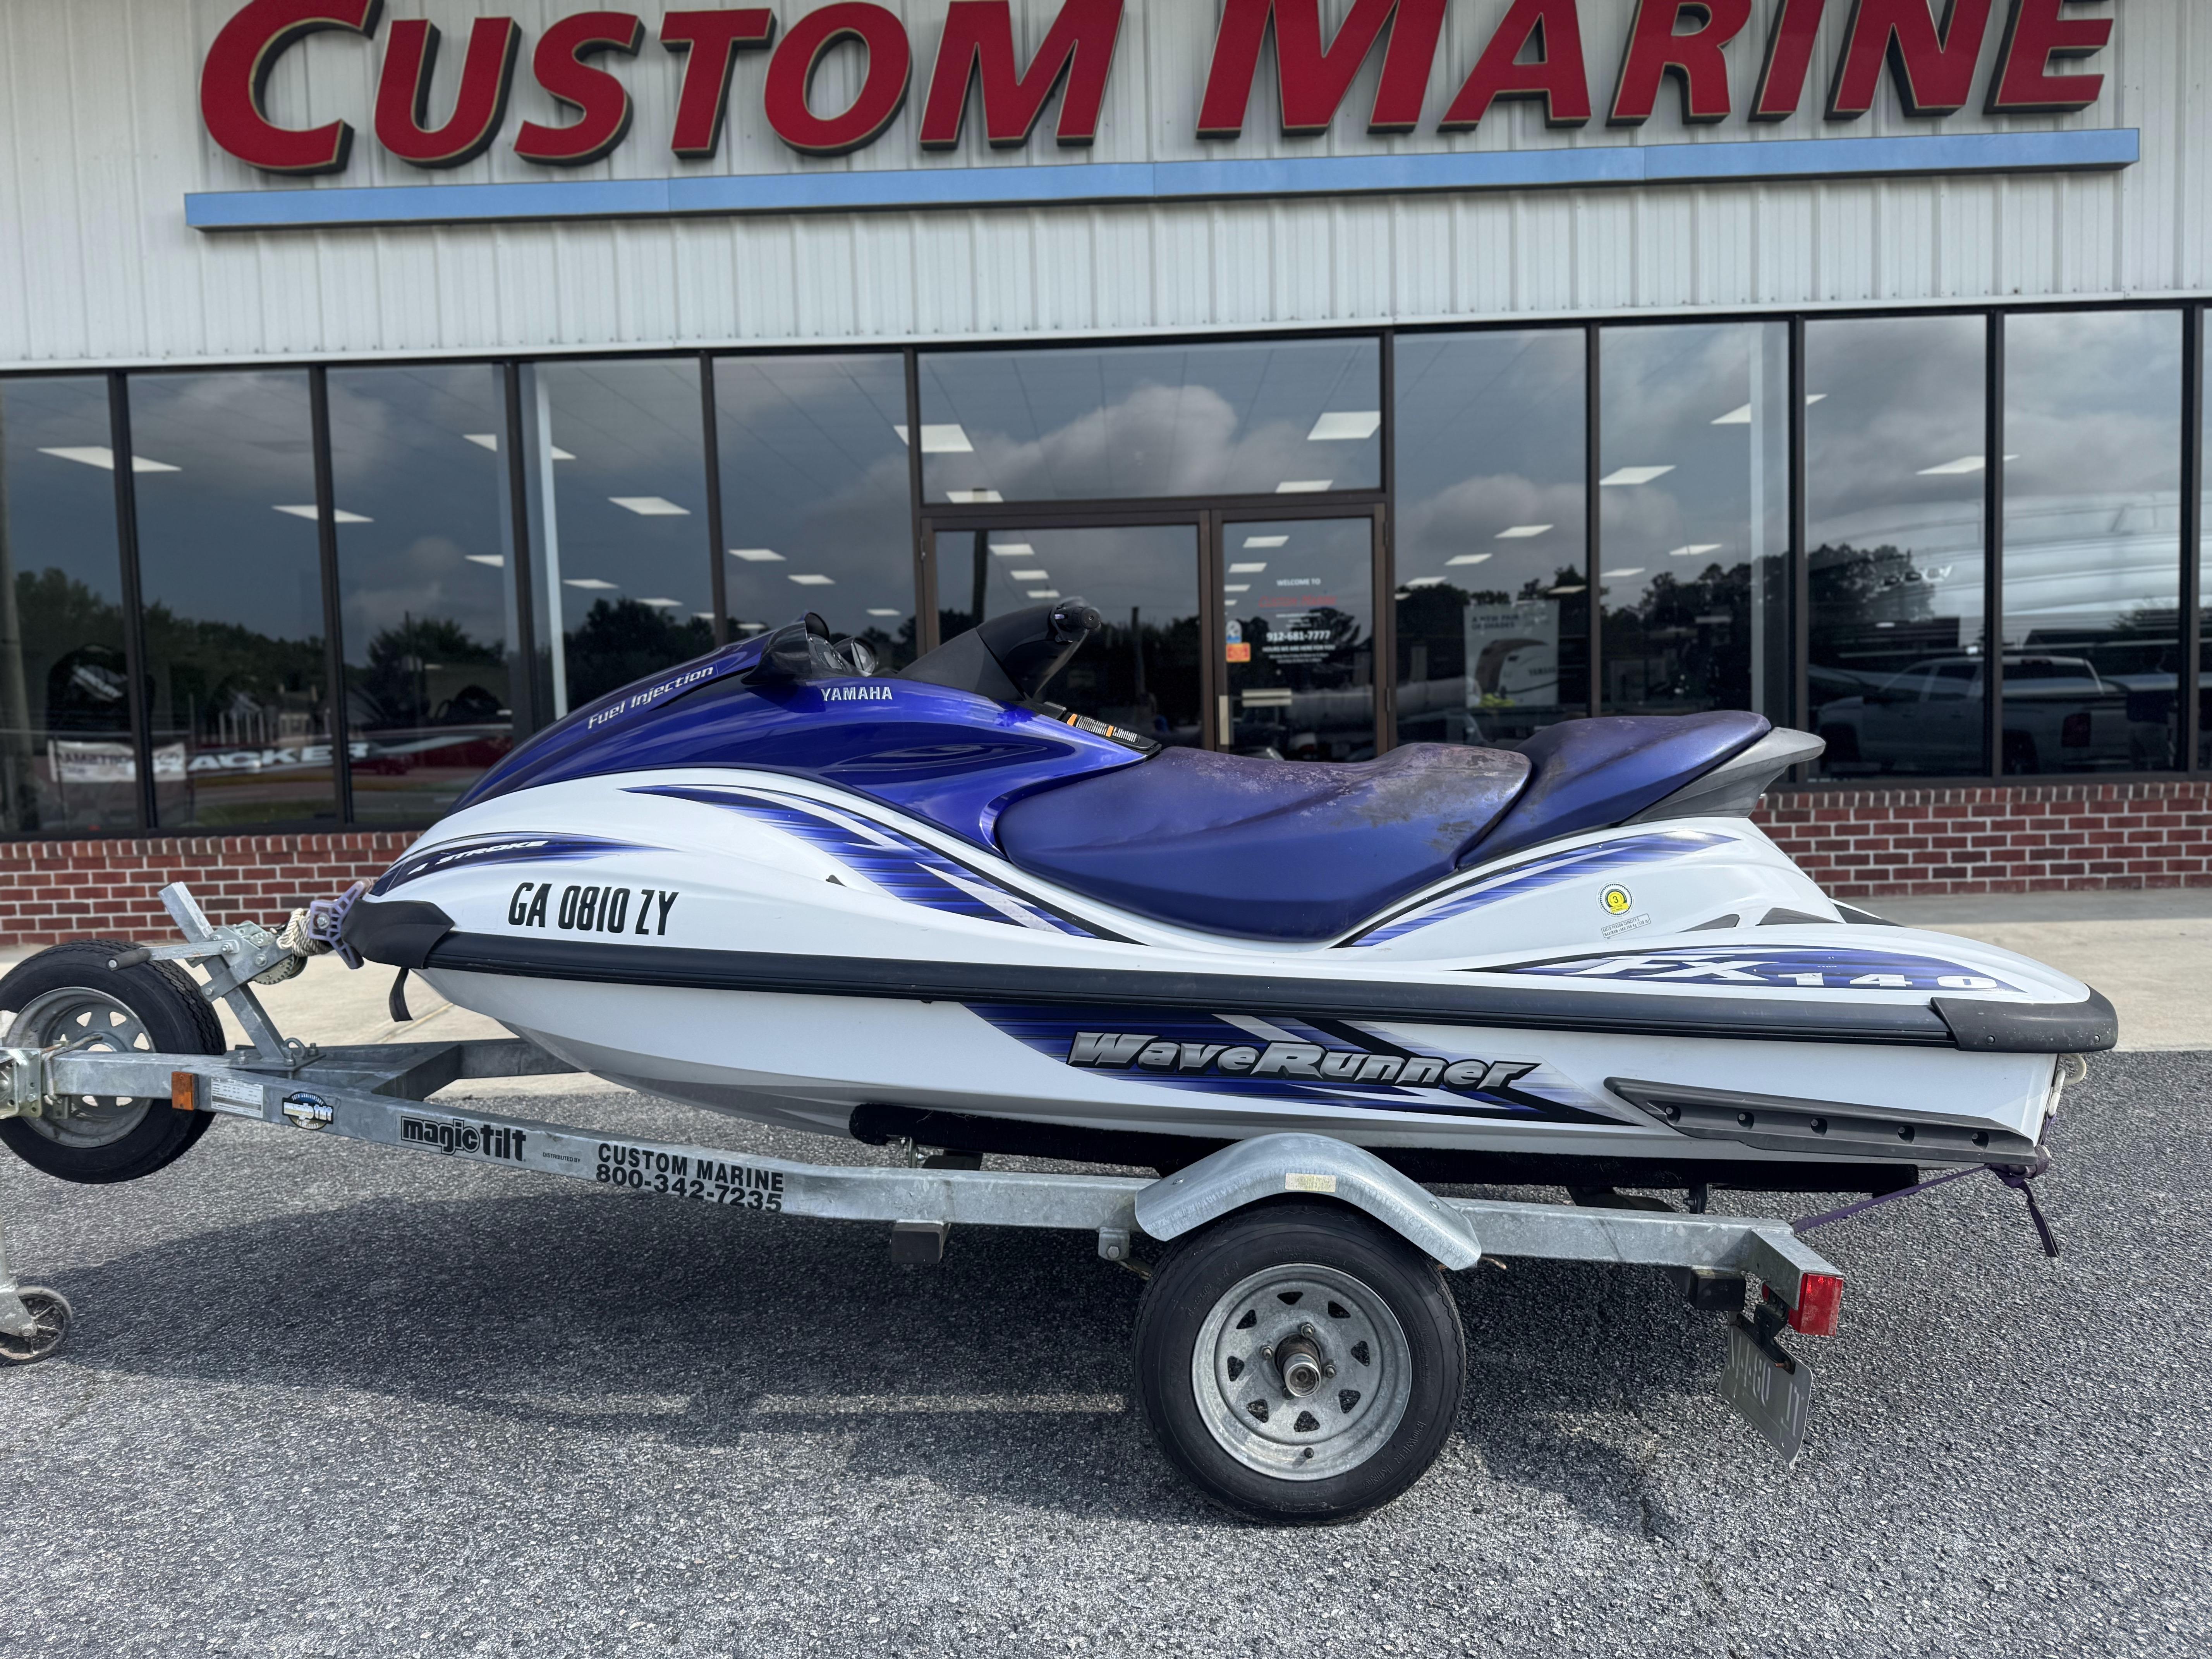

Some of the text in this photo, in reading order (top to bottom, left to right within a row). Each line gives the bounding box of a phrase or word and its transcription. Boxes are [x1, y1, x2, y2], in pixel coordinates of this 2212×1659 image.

[199, 0, 2115, 175] CUSTOM MARINE
[1276, 577, 1321, 586] WELCOME TO
[1266, 630, 1331, 642] 912-681-7777
[588, 666, 713, 729] Fuel Injection
[821, 687, 893, 701] YAMAHA
[407, 840, 548, 875] 4 STROKE
[508, 882, 679, 936] GA 0810 ZY
[1066, 1030, 1542, 1091] WaveRunner
[401, 1116, 526, 1161] magic tilt
[543, 1152, 573, 1162] DISTRIBUTED
[596, 1164, 782, 1212] 800-342-7235
[598, 1143, 784, 1192] CUSTOM MARINE
[1363, 1421, 1426, 1488] POWER KING
